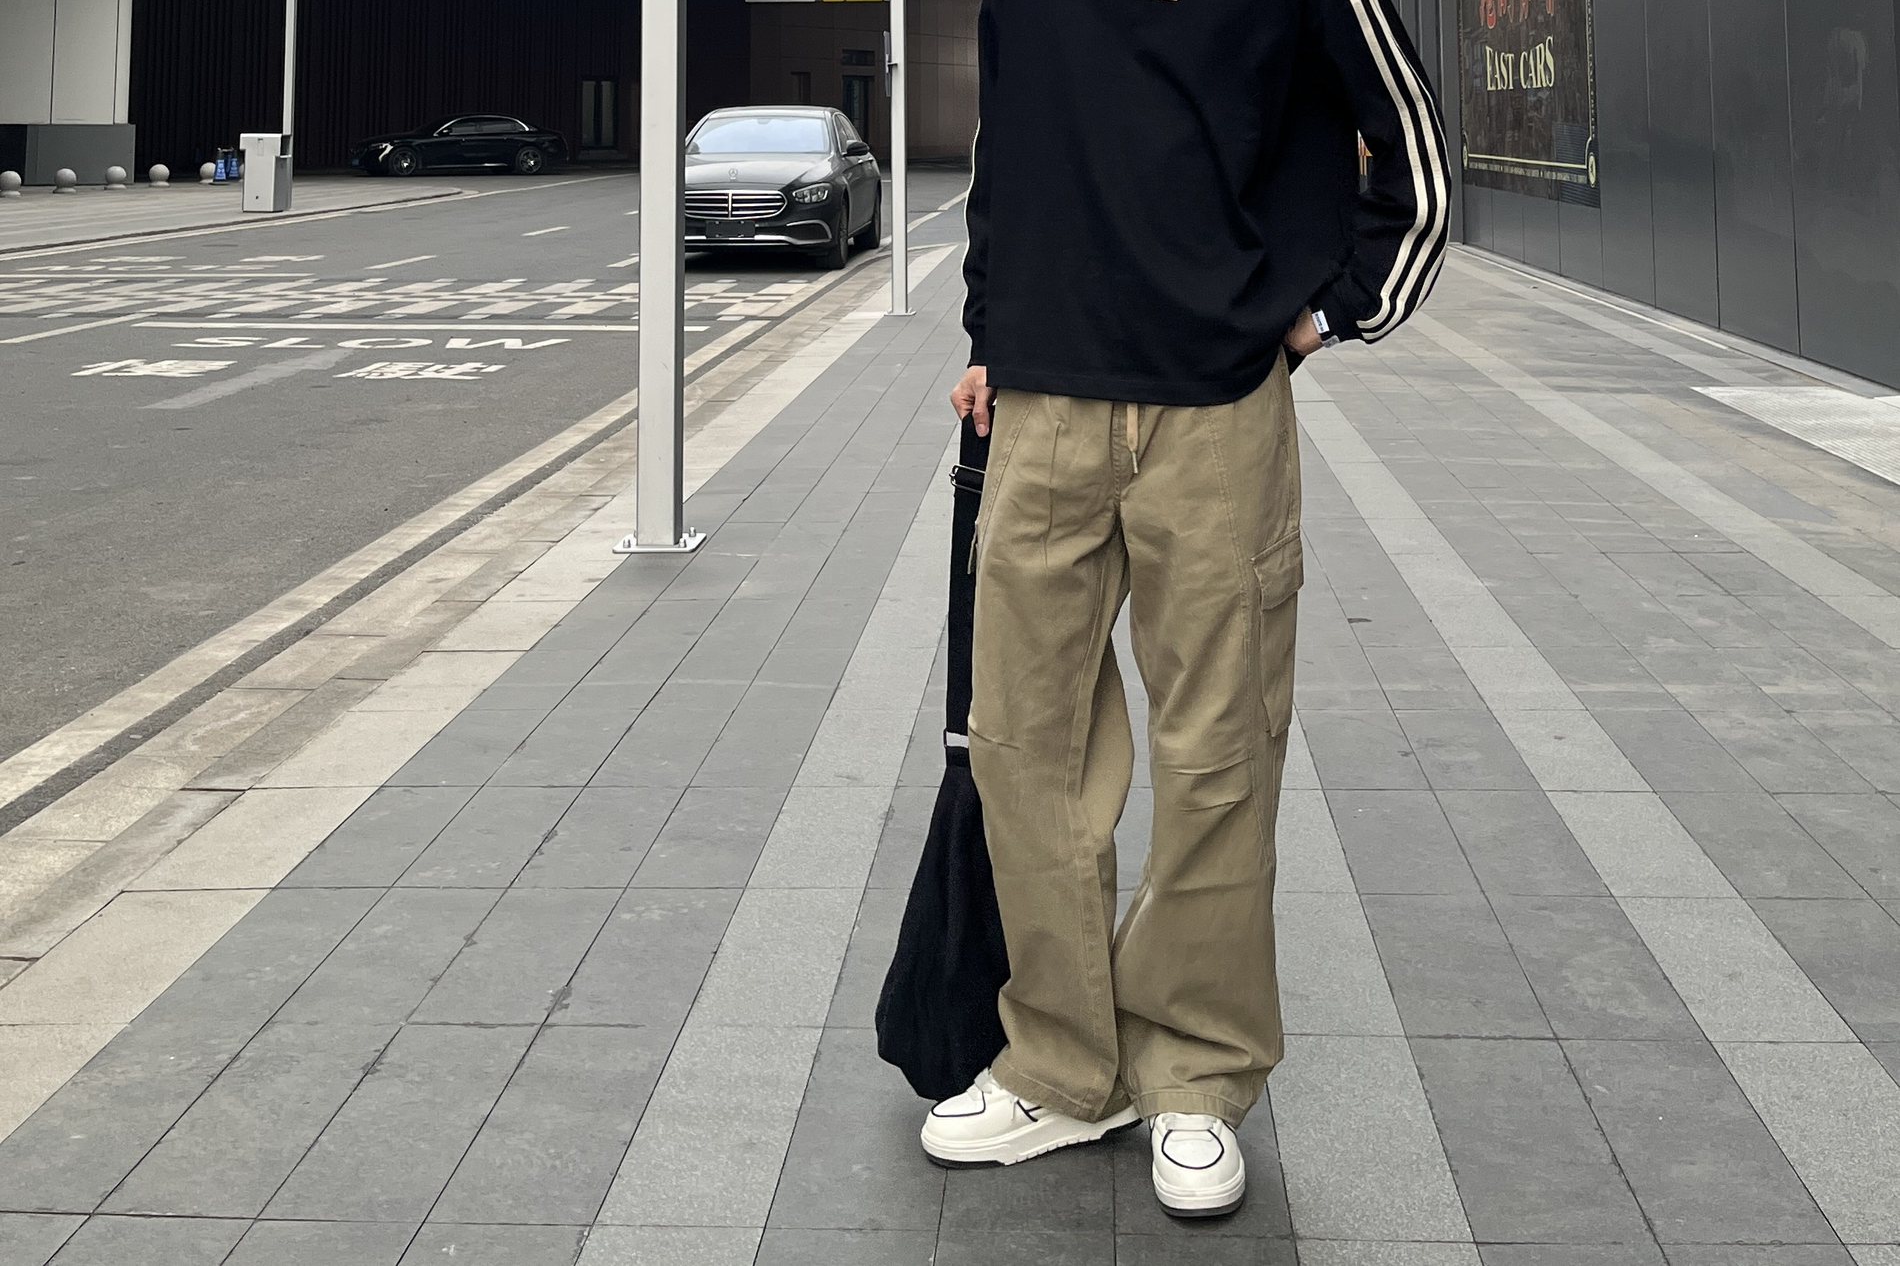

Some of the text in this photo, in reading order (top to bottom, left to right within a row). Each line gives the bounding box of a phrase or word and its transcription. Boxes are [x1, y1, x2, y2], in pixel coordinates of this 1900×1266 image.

[1485, 34, 1554, 91] EAST CARS
[169, 336, 573, 350] SLOW
